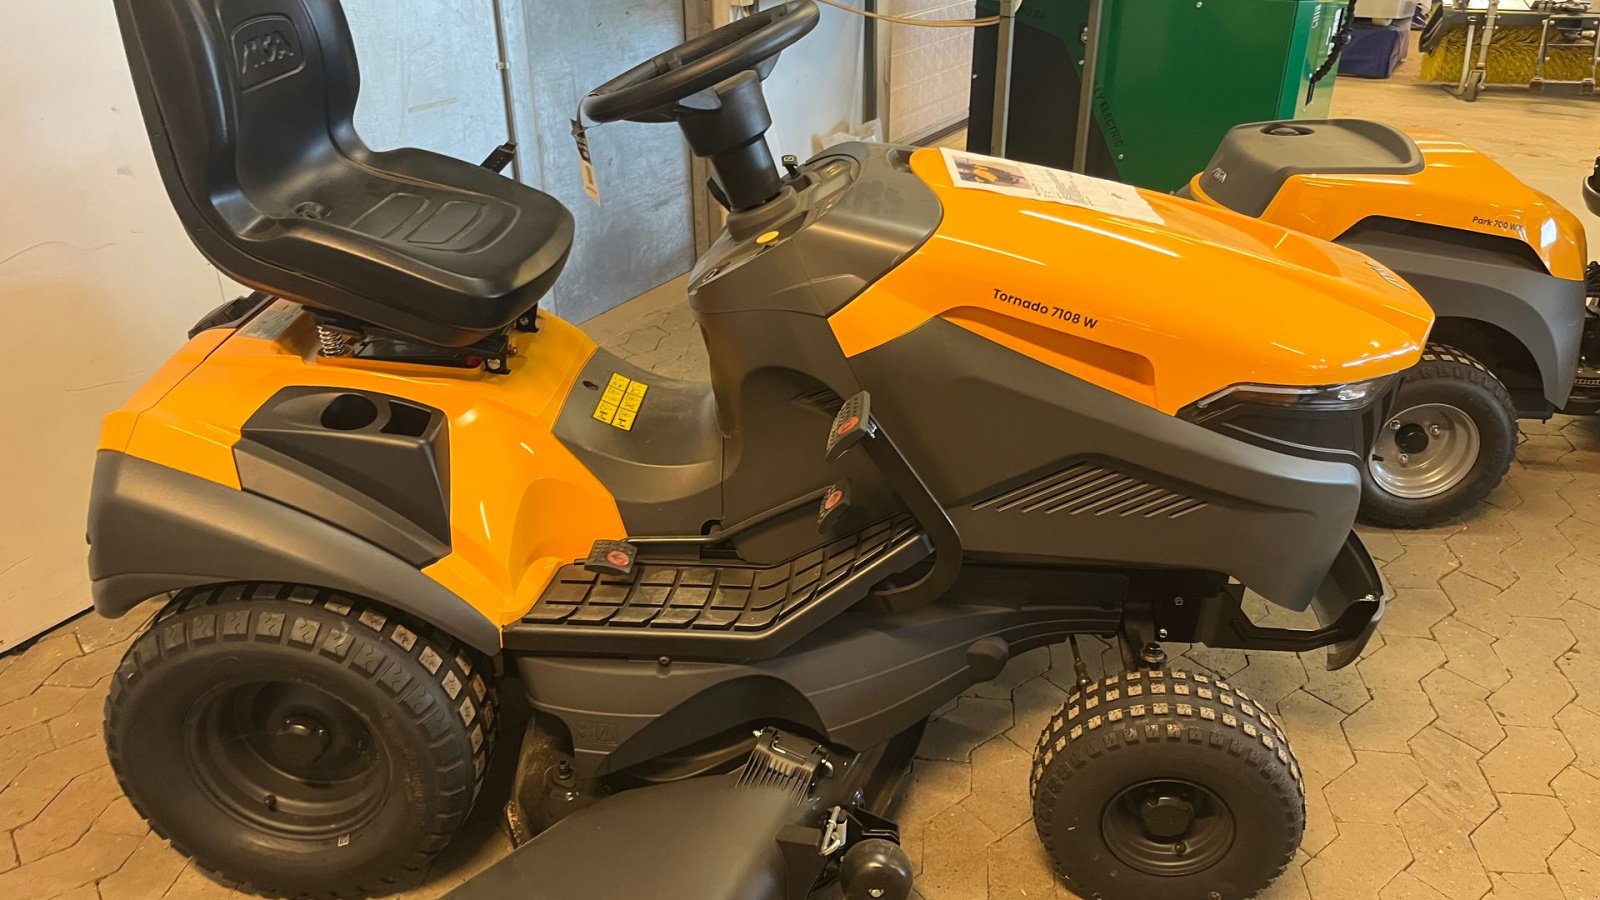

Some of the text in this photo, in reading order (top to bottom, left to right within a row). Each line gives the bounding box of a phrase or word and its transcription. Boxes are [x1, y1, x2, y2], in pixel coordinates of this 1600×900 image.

[1099, 101, 1124, 148] ELECTRIC
[1472, 216, 1492, 227] Park
[1494, 220, 1509, 229] 700
[993, 288, 1098, 329] Tornado 7108 W
